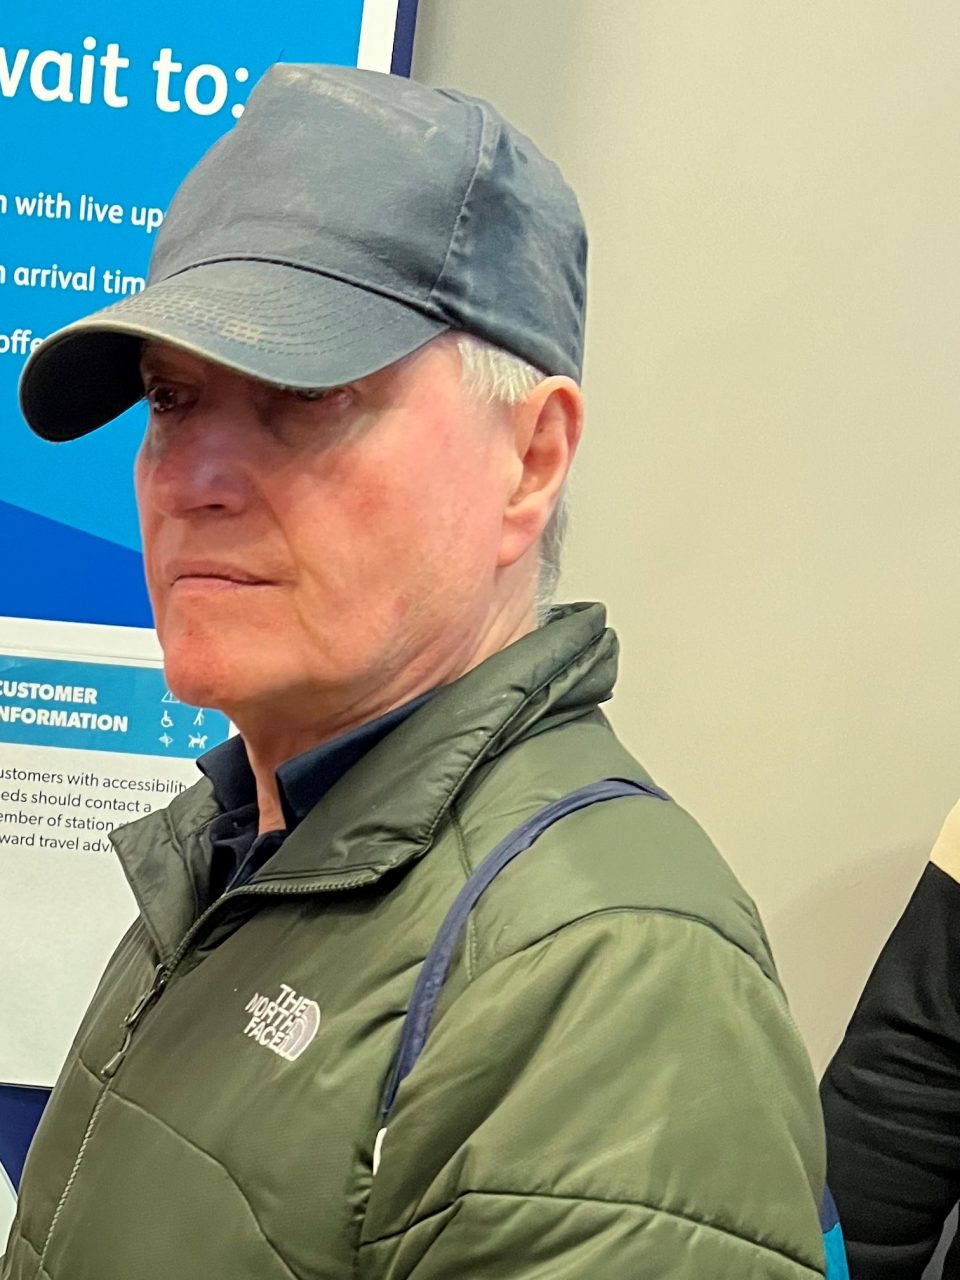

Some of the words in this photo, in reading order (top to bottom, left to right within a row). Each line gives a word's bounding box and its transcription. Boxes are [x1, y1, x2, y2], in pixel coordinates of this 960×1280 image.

[152, 48, 249, 119] to:
[15, 192, 71, 219] with
[79, 194, 123, 224] live
[131, 206, 167, 234] up
[13, 264, 95, 291] arrival
[67, 771, 99, 788] with
[31, 790, 81, 807] should
[85, 797, 140, 813] contact
[143, 803, 152, 813] a
[47, 811, 62, 827] of
[65, 814, 114, 832] station
[39, 833, 79, 850] travel
[244, 992, 295, 1034] NORTH
[276, 984, 310, 1017] THE
[243, 1016, 285, 1051] FACE
